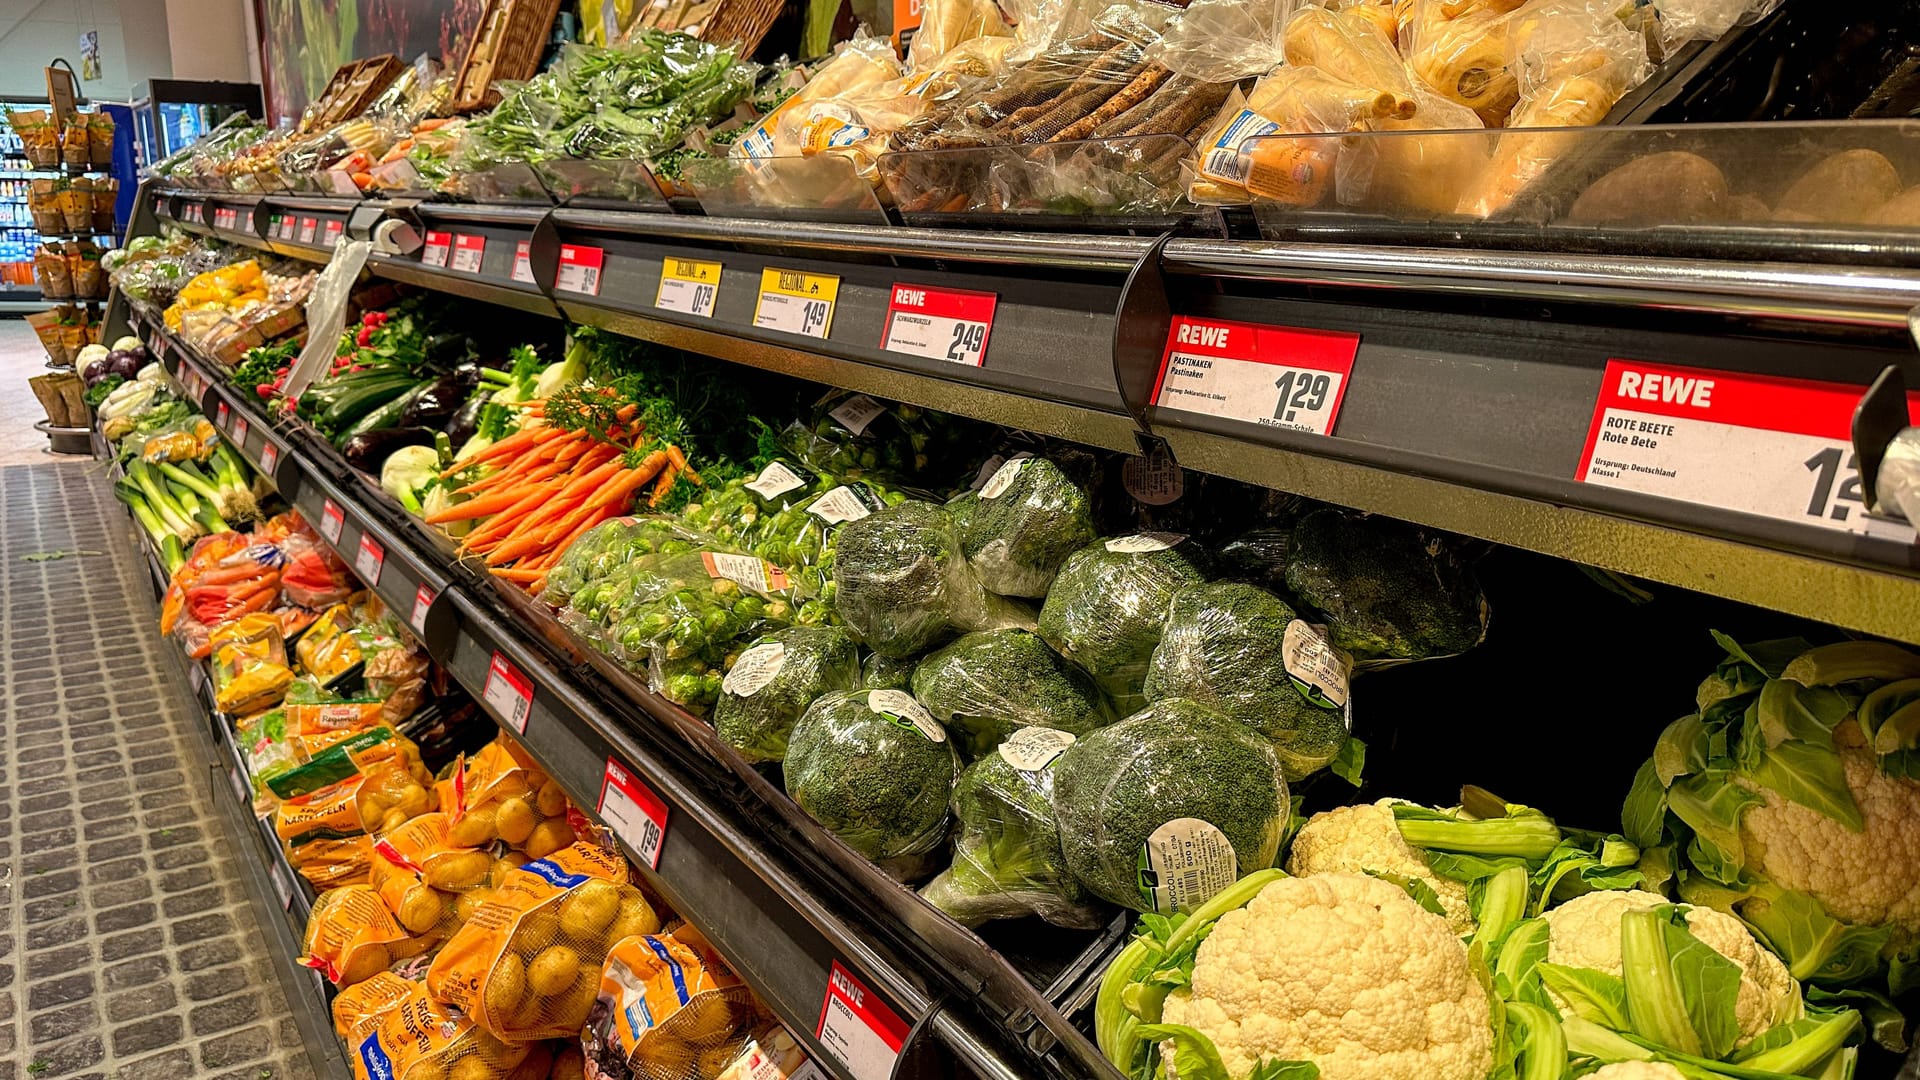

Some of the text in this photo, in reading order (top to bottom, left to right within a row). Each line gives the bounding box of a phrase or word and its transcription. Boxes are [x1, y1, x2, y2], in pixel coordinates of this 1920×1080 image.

[778, 271, 807, 293] REGIONAL
[692, 285, 713, 313] 0.79
[895, 288, 926, 307] REWE
[801, 301, 826, 333] 1.49
[946, 322, 985, 361] 2.49
[1176, 323, 1230, 348] REWE
[1170, 366, 1204, 379] Pastinaken
[1173, 356, 1213, 369] PASTINAKEN
[1273, 370, 1330, 422] 1.29
[1616, 370, 1715, 408] REWE
[1606, 416, 1675, 437] ROTE BEETE
[1602, 431, 1657, 449] Rote Bete
[1591, 467, 1616, 479] Klasse
[1594, 457, 1677, 478] Ursprung: Deutschland
[1315, 670, 1344, 695] BROCCOLI
[607, 761, 628, 786] REWE
[640, 818, 661, 853] 1.99
[1166, 870, 1179, 913] BROCCOLI
[832, 968, 864, 1009] REWE
[416, 998, 435, 1031] SPEISE-
[832, 998, 853, 1021] BROCCOLI
[402, 1000, 432, 1054] KARTOFFELN
